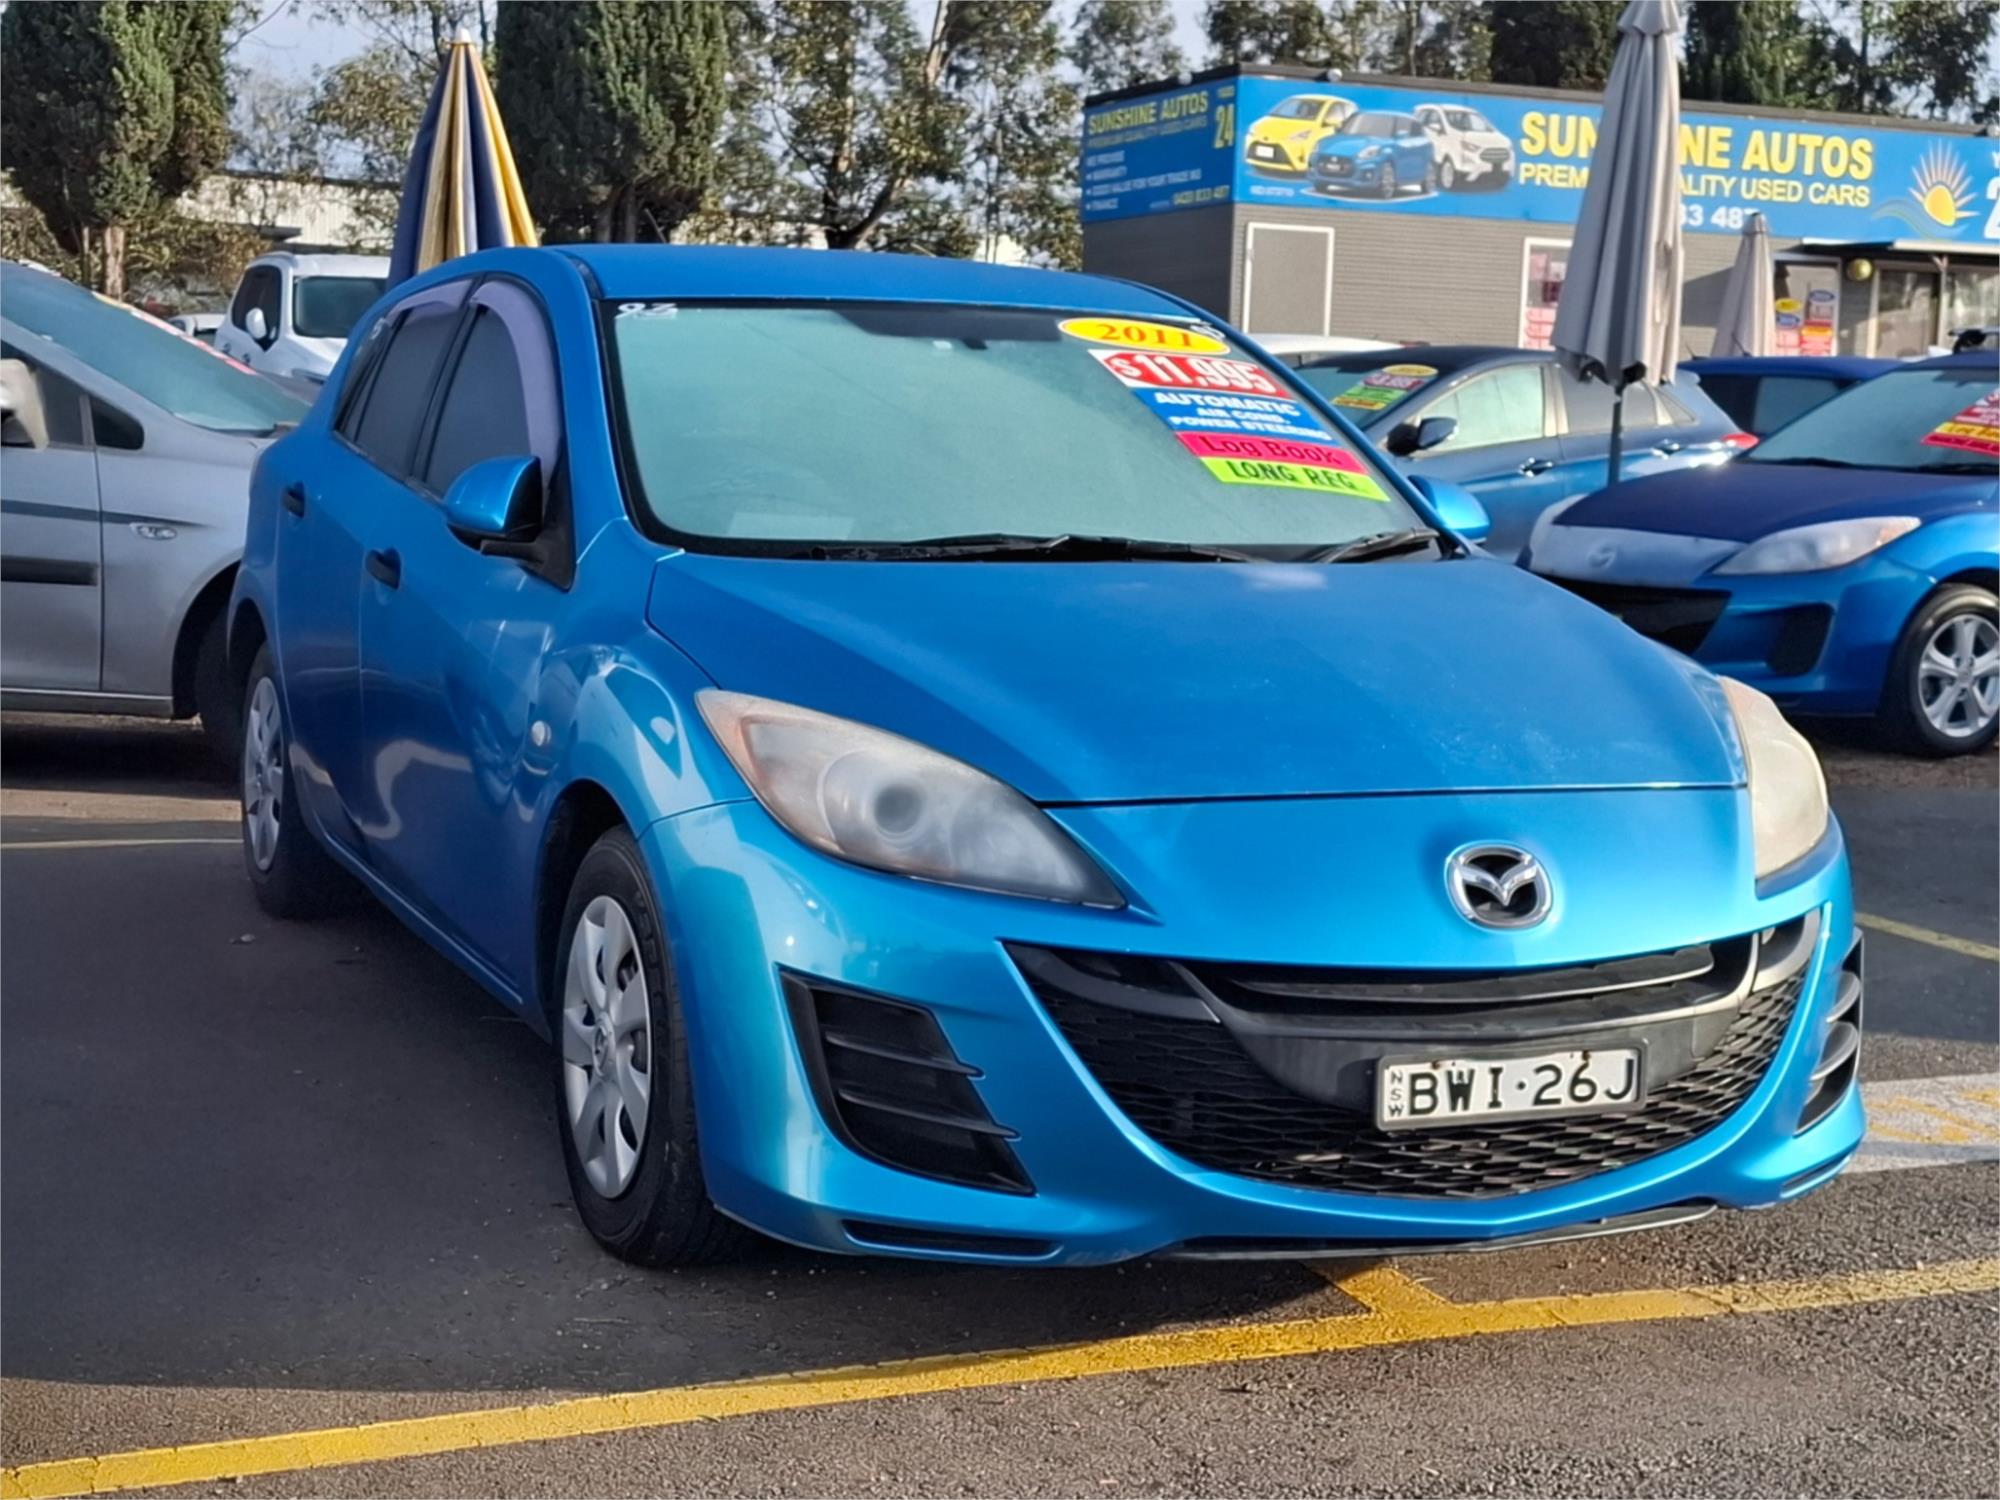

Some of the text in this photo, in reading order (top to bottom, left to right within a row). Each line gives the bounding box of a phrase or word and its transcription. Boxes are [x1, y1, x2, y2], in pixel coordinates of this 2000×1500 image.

[1088, 101, 1157, 135] SUNSHINE
[1160, 91, 1209, 120] AUTOS
[1214, 104, 1235, 148] 24
[1521, 111, 1873, 180] SUNNE AUTOS
[1519, 162, 1589, 189] PREM
[1741, 177, 1803, 203] USED
[1808, 181, 1870, 208] CARS
[1096, 323, 1192, 347] 2011
[1109, 354, 1277, 394] $11,995
[1154, 392, 1301, 417] AUTOMATIC
[1196, 408, 1231, 418] AIR
[1168, 416, 1333, 441] POWER STEERING
[1199, 435, 1342, 465] Log Book
[1226, 460, 1359, 490] LONG REG
[1388, 1070, 1405, 1118] NSW
